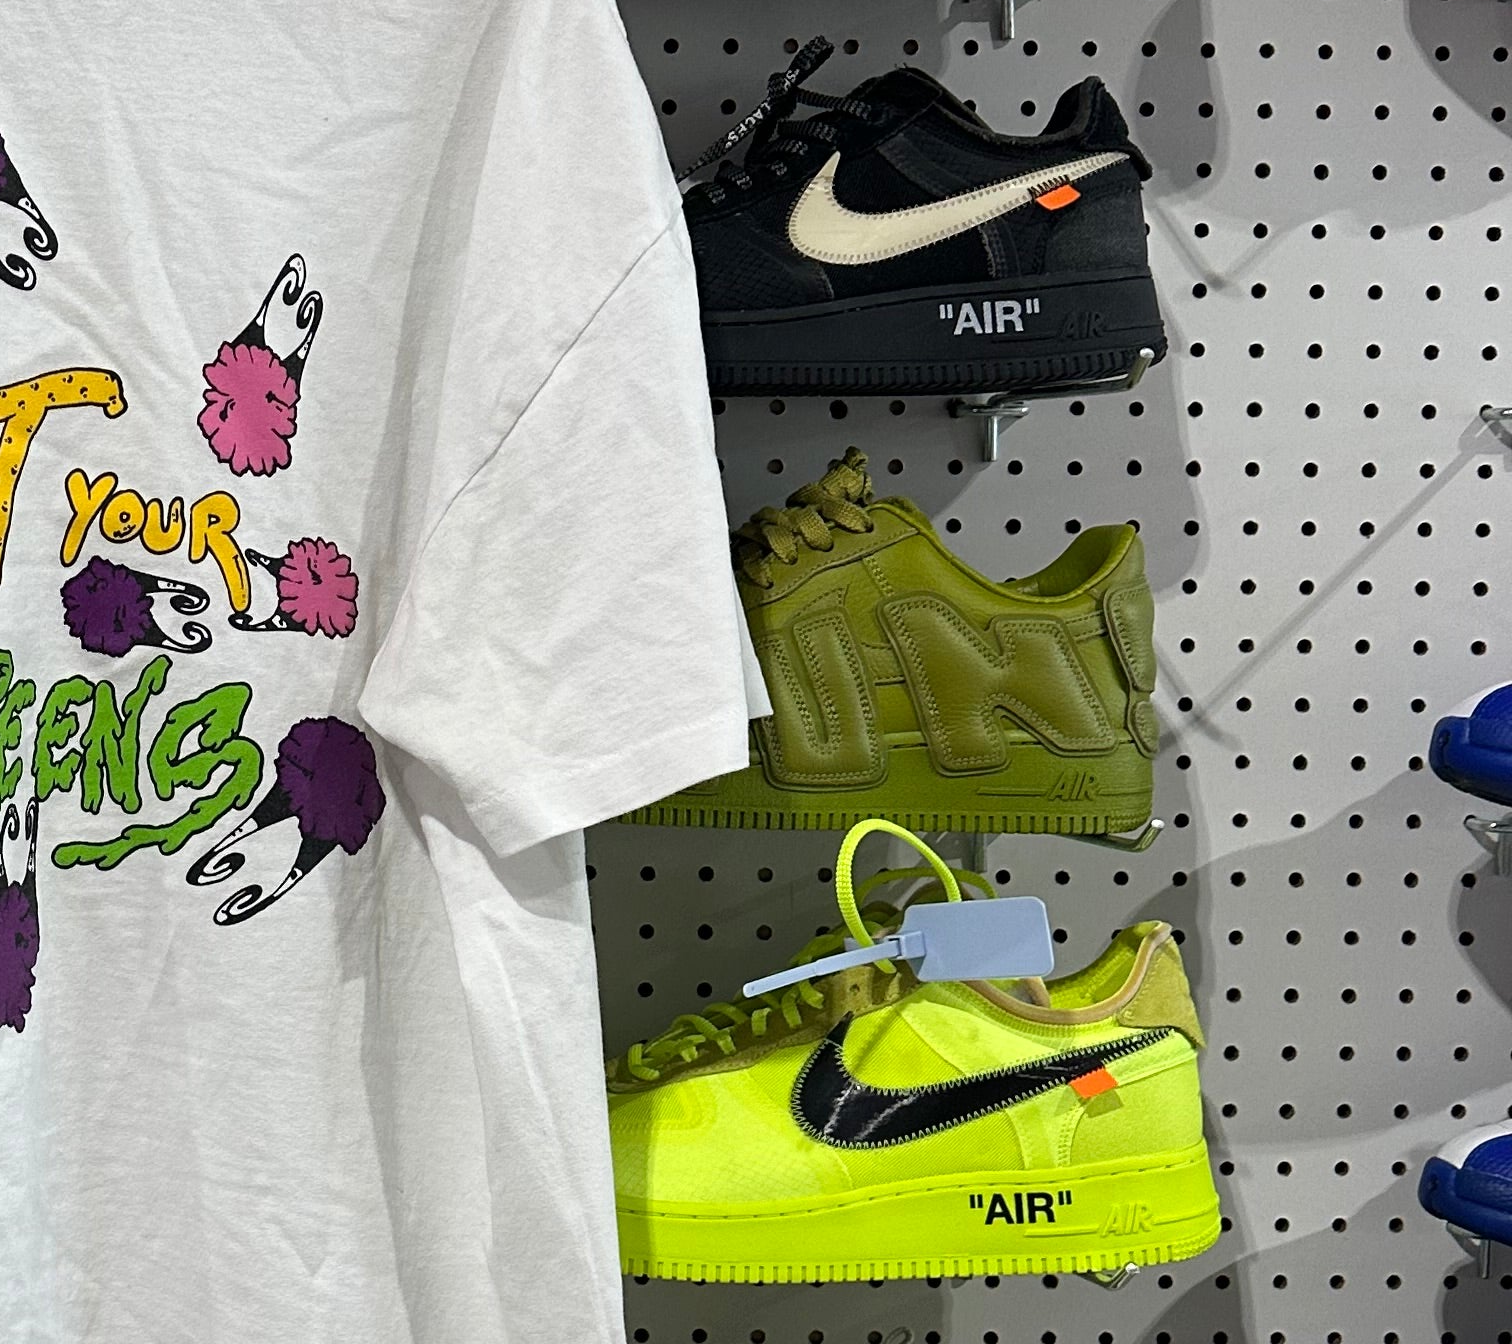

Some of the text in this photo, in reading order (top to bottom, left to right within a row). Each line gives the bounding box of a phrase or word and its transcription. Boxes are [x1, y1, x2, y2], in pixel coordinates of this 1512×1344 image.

[939, 297, 1041, 336] "AIR"
[60, 469, 251, 613] YOUR
[1048, 770, 1099, 802] AIR
[969, 1190, 1073, 1226] "AIR"
[1099, 1201, 1154, 1239] AIR
